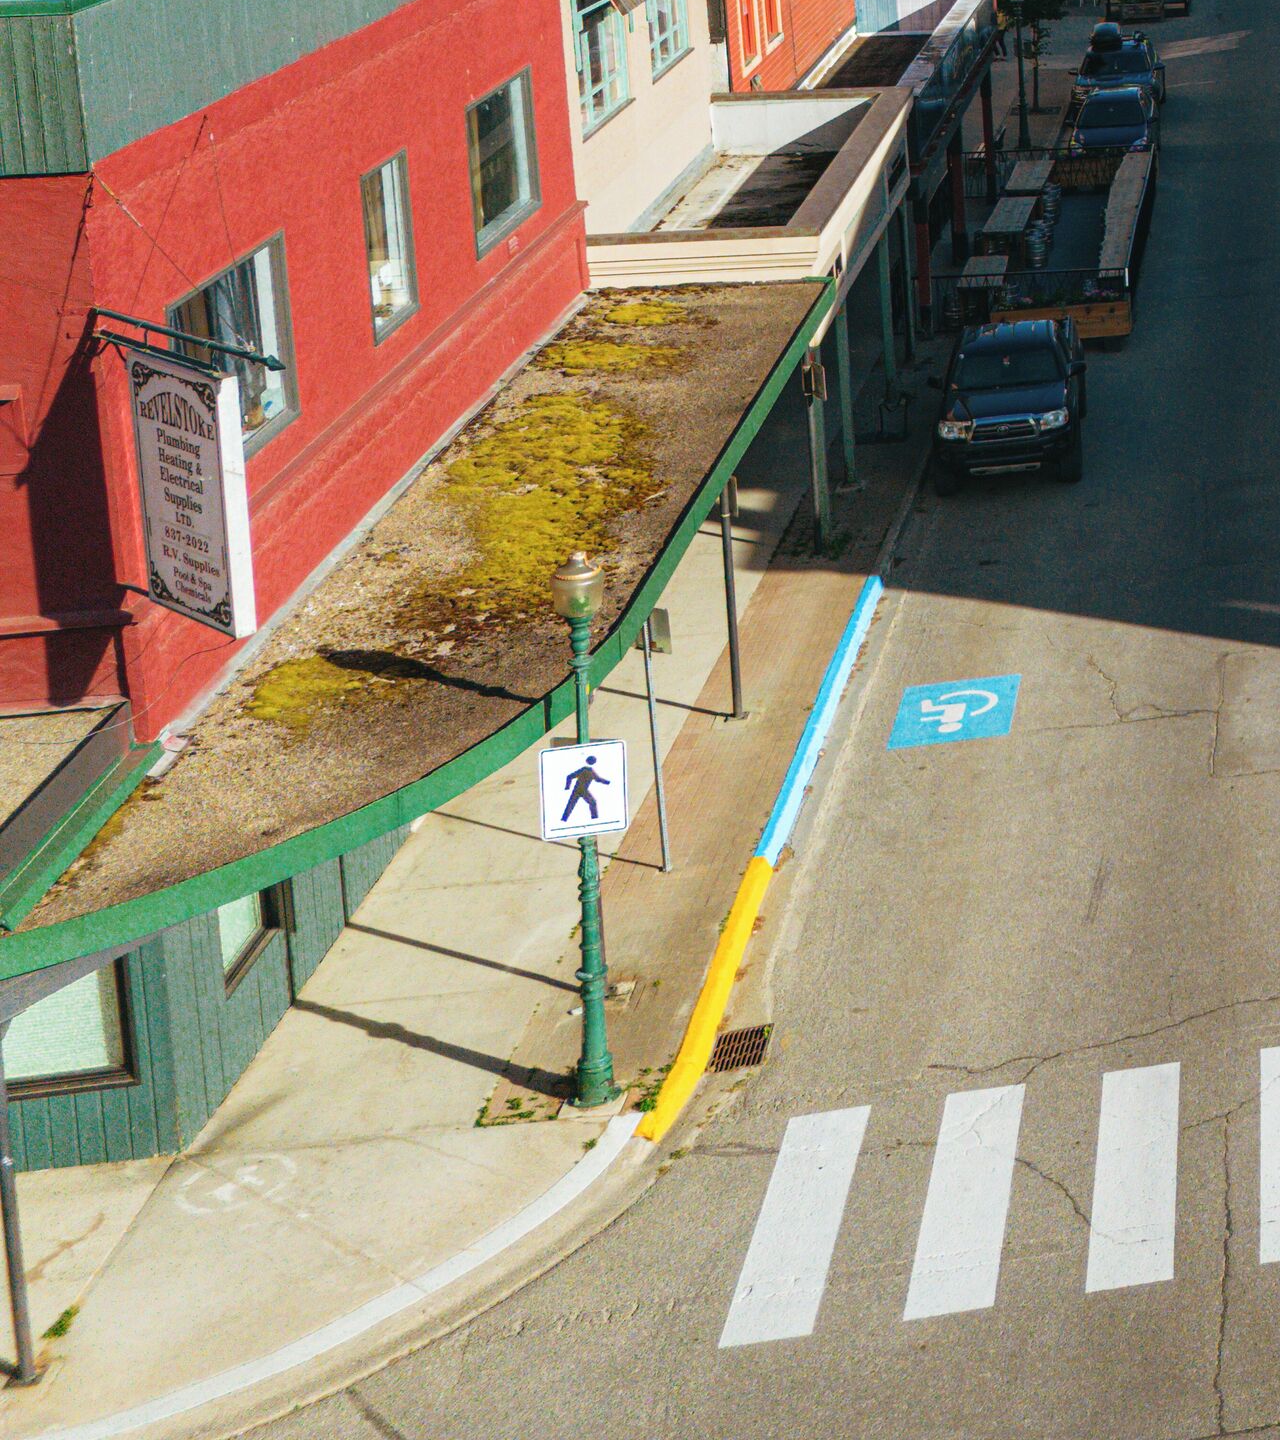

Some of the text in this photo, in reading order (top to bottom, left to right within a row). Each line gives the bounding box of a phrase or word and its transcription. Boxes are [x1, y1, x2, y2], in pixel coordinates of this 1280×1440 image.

[139, 392, 214, 440] REVELSTOKE
[156, 428, 200, 459] Plumbing
[158, 447, 202, 476] Heating &
[160, 465, 203, 495] Electrical
[164, 487, 203, 514] Supplies
[175, 512, 195, 528] LTD.
[164, 526, 209, 553] 837-2022
[162, 544, 220, 577] R.V. Supplies
[173, 566, 212, 592] Pool & Spa
[175, 580, 212, 604] Chemicals
